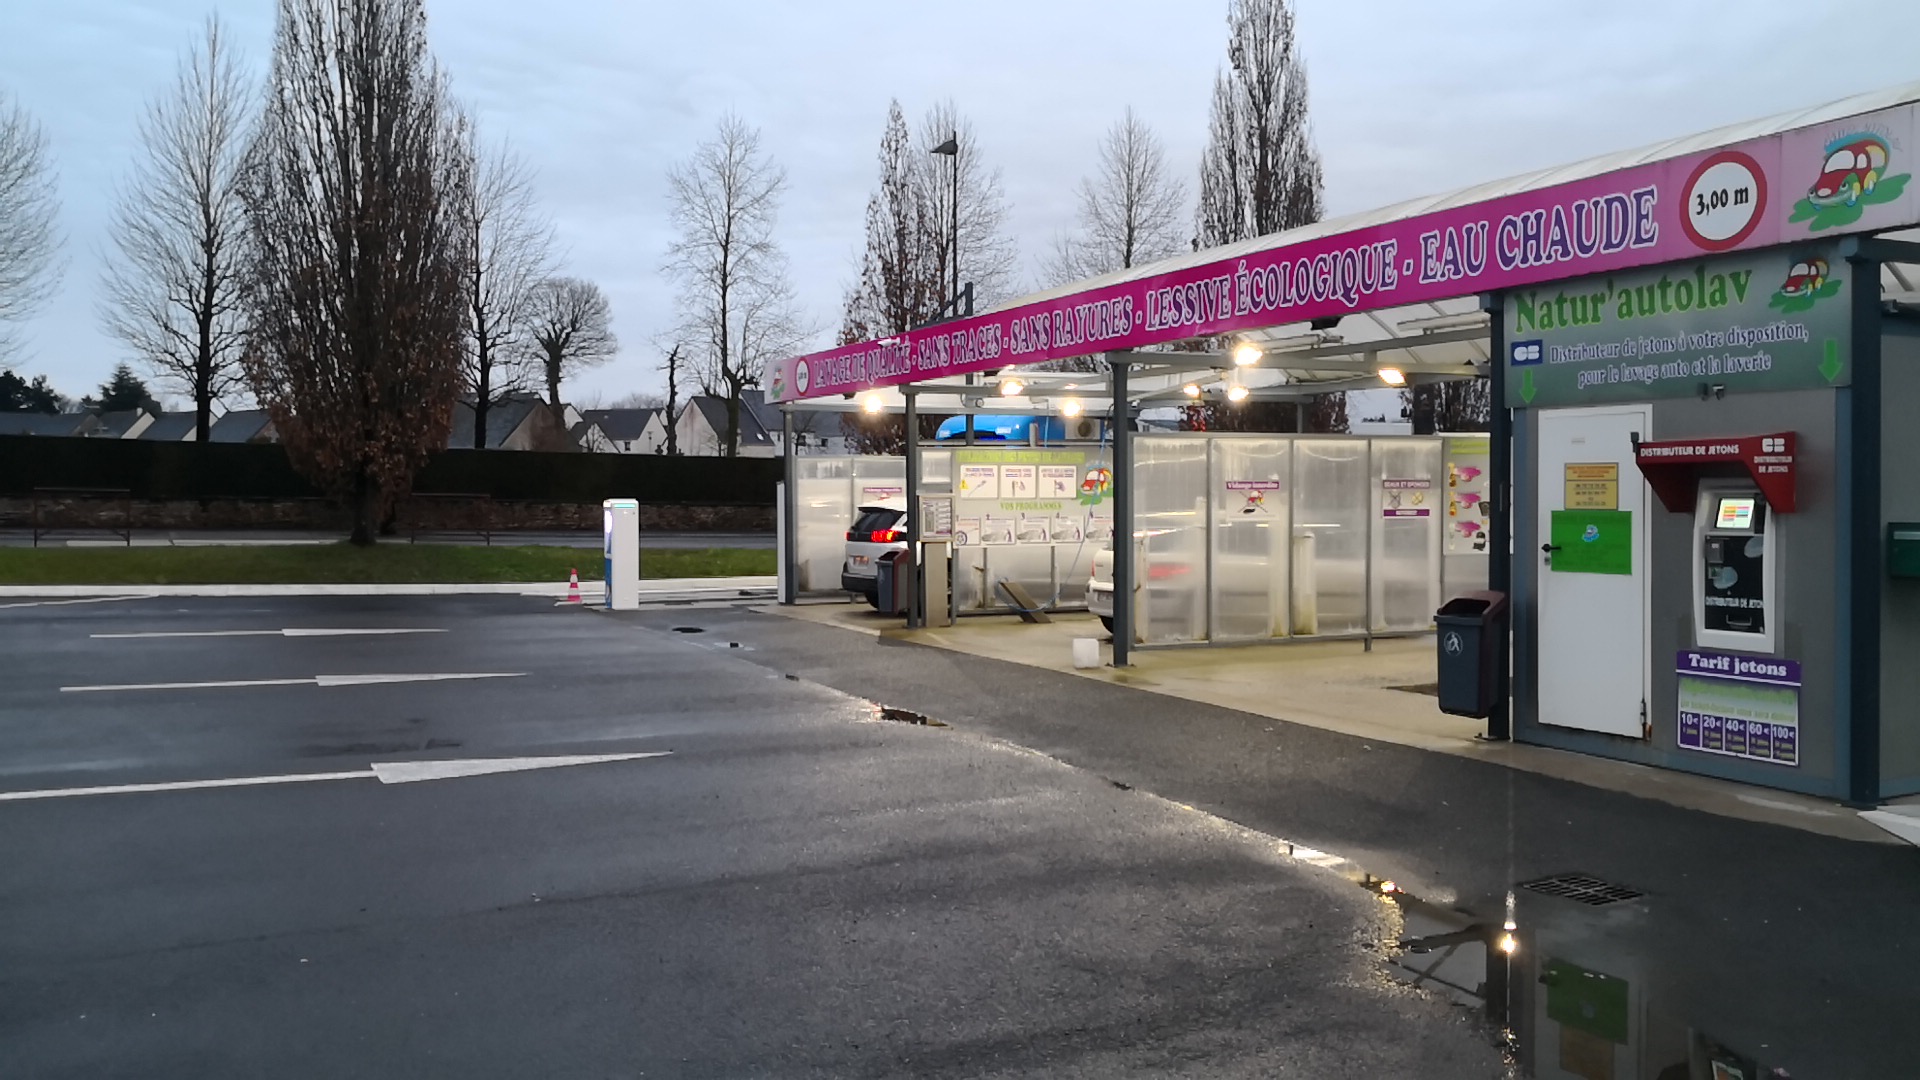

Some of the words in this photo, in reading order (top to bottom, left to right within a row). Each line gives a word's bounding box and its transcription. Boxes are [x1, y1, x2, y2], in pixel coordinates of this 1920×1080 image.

[1695, 188, 1728, 216] 3,00
[1734, 186, 1749, 206] m
[814, 354, 850, 388] LAVAGE
[850, 352, 866, 382] DE
[917, 334, 949, 371] SANS
[952, 324, 1001, 365] TRACES
[1010, 312, 1050, 355] SANS
[1052, 295, 1133, 348] RAYURES
[1145, 275, 1231, 331] LESSIVE
[1235, 238, 1397, 316] ÉCOLOGIQUE
[1419, 221, 1489, 284] EAU
[1496, 185, 1658, 271] CHAUDE
[1514, 264, 1752, 333] Natur'autolav
[1550, 342, 1620, 364] Distributeur
[1622, 337, 1637, 356] de
[1638, 336, 1676, 360] jetons
[1678, 330, 1686, 351] à
[1688, 330, 1724, 350] votre
[1726, 320, 1809, 348] disposition,
[1578, 368, 1607, 389] pour
[1608, 364, 1619, 384] le
[1621, 363, 1659, 384] lavage
[1661, 358, 1690, 379] auto
[1691, 356, 1706, 376] et
[1708, 354, 1721, 375] la
[1723, 350, 1772, 373] laverie
[1640, 446, 1694, 457] DISTRIBUTEUR
[1695, 446, 1706, 456] DE
[1708, 444, 1740, 455] JETONS
[1689, 653, 1730, 671] Tarif
[1734, 657, 1787, 676] jetons
